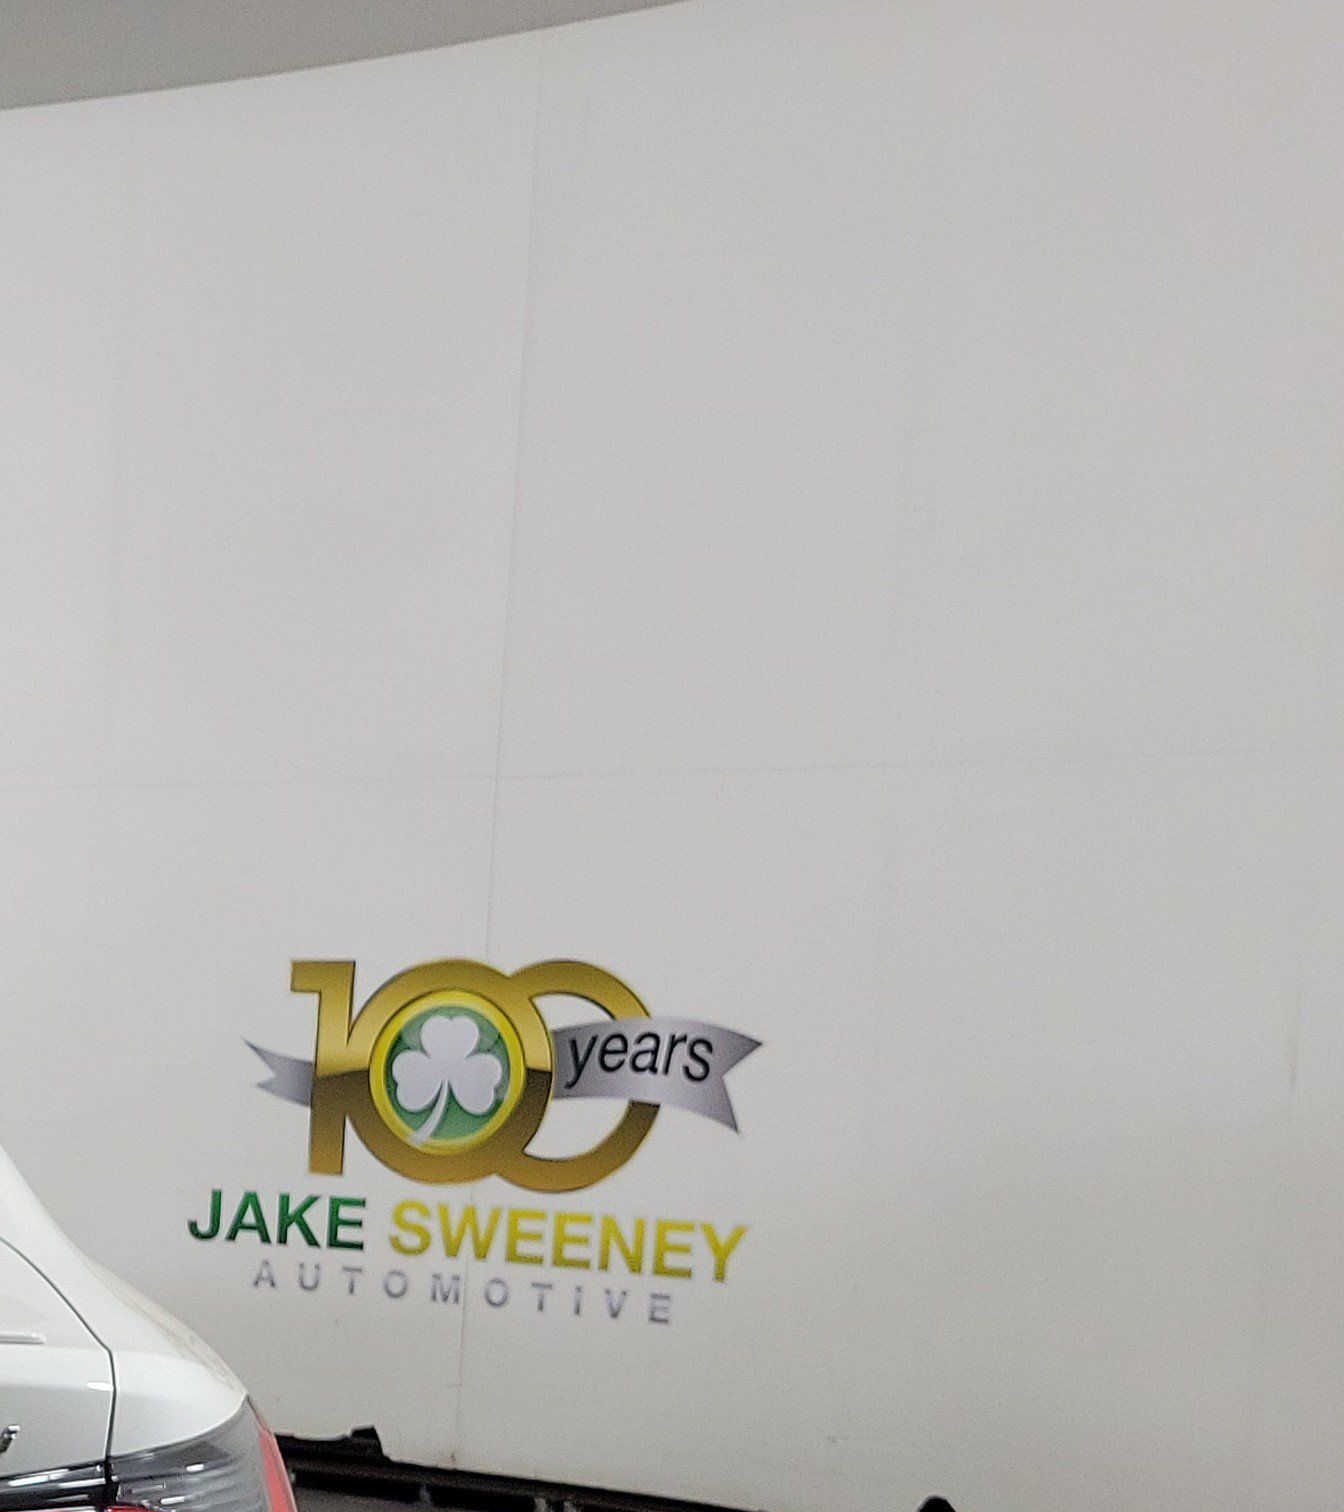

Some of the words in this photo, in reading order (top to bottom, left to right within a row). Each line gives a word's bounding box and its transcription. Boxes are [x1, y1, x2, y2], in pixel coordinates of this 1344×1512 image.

[565, 1029, 714, 1090] years
[188, 1189, 366, 1251] JAKE
[389, 1198, 748, 1283] SWEENEY
[253, 1259, 672, 1323] AUTOMOTIVE
